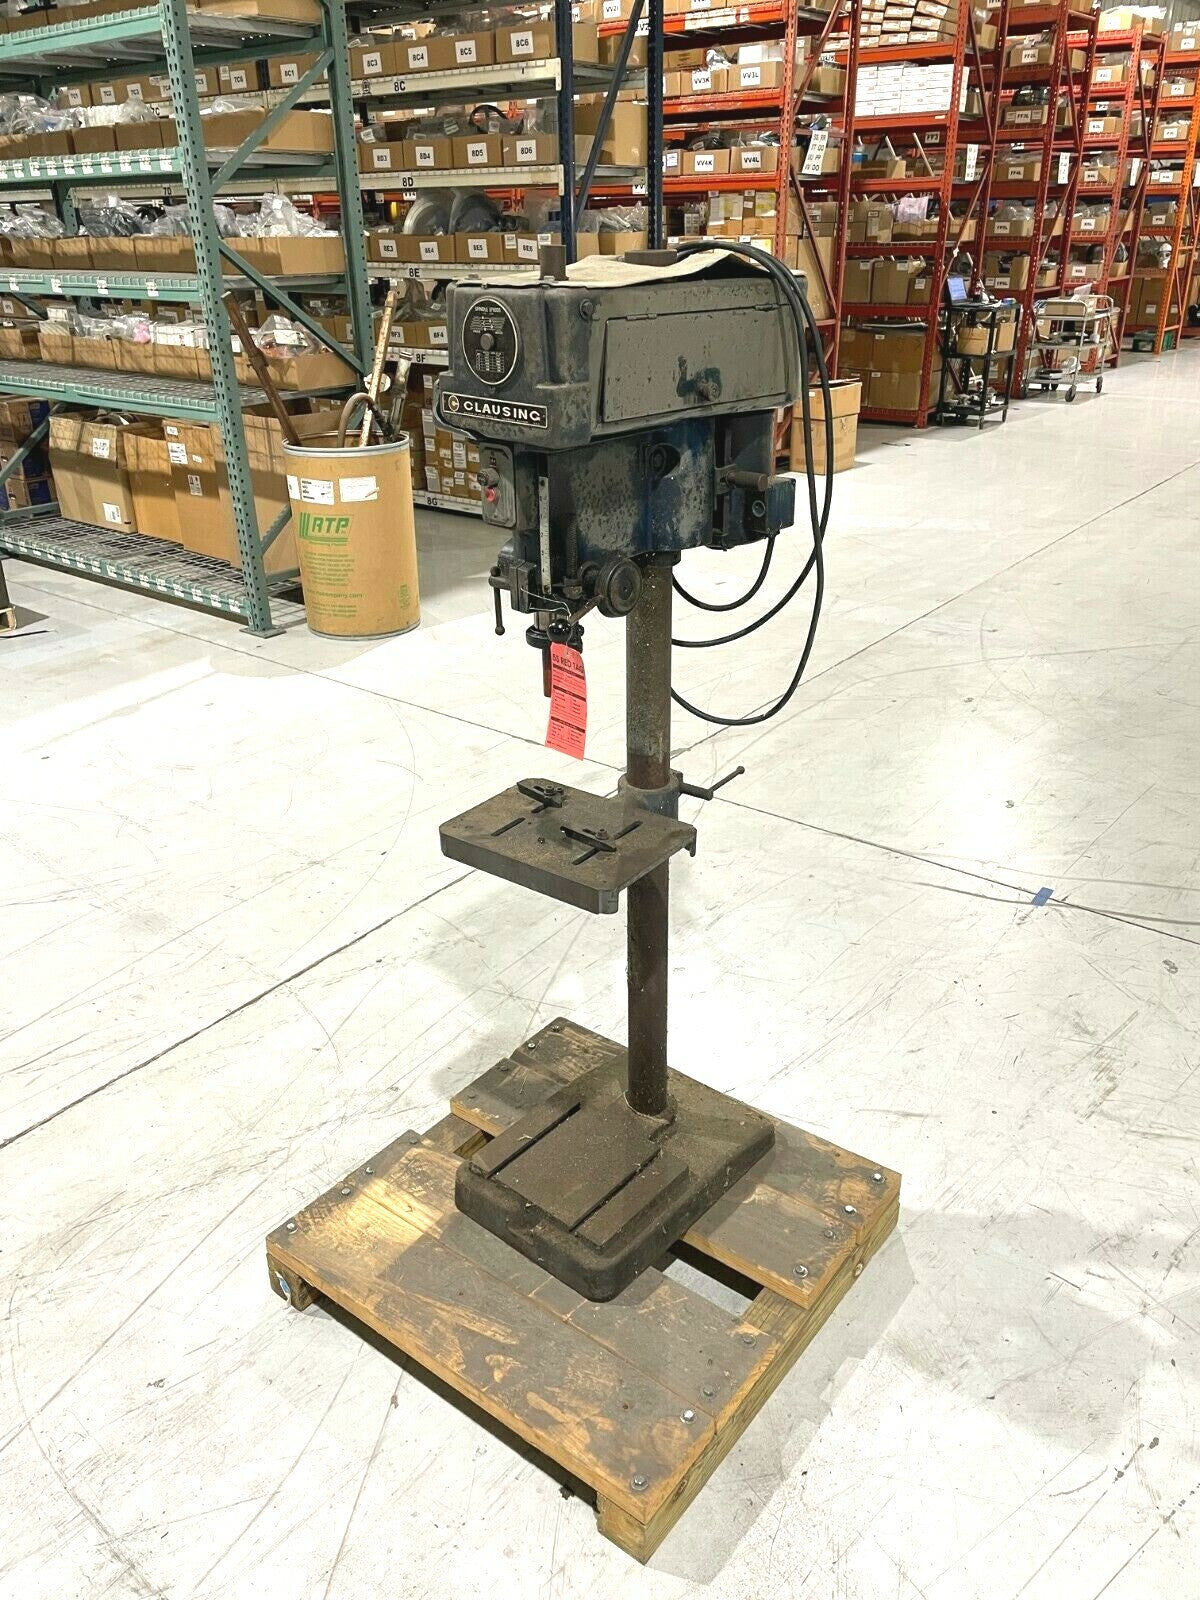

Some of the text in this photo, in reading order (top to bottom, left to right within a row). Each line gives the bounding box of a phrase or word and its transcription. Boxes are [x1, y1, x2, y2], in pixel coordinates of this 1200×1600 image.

[515, 38, 530, 48] 8C6
[459, 47, 472, 56] 8C5
[412, 52, 424, 62] 8C4
[366, 58, 378, 68] 8C3
[394, 80, 406, 92] 8C
[471, 149, 484, 158] 8D5
[520, 146, 533, 155] 8D6
[376, 154, 388, 162] 8D3
[419, 152, 431, 161] 8D4
[402, 176, 414, 188] 8D
[383, 244, 394, 252] 8E3
[408, 267, 420, 278] 8E
[416, 354, 426, 363] 8F
[463, 400, 541, 421] CLAUSING
[426, 496, 438, 506] 8G
[312, 517, 350, 534] RTP
[560, 656, 572, 668] RED
[572, 662, 584, 674] TAG
